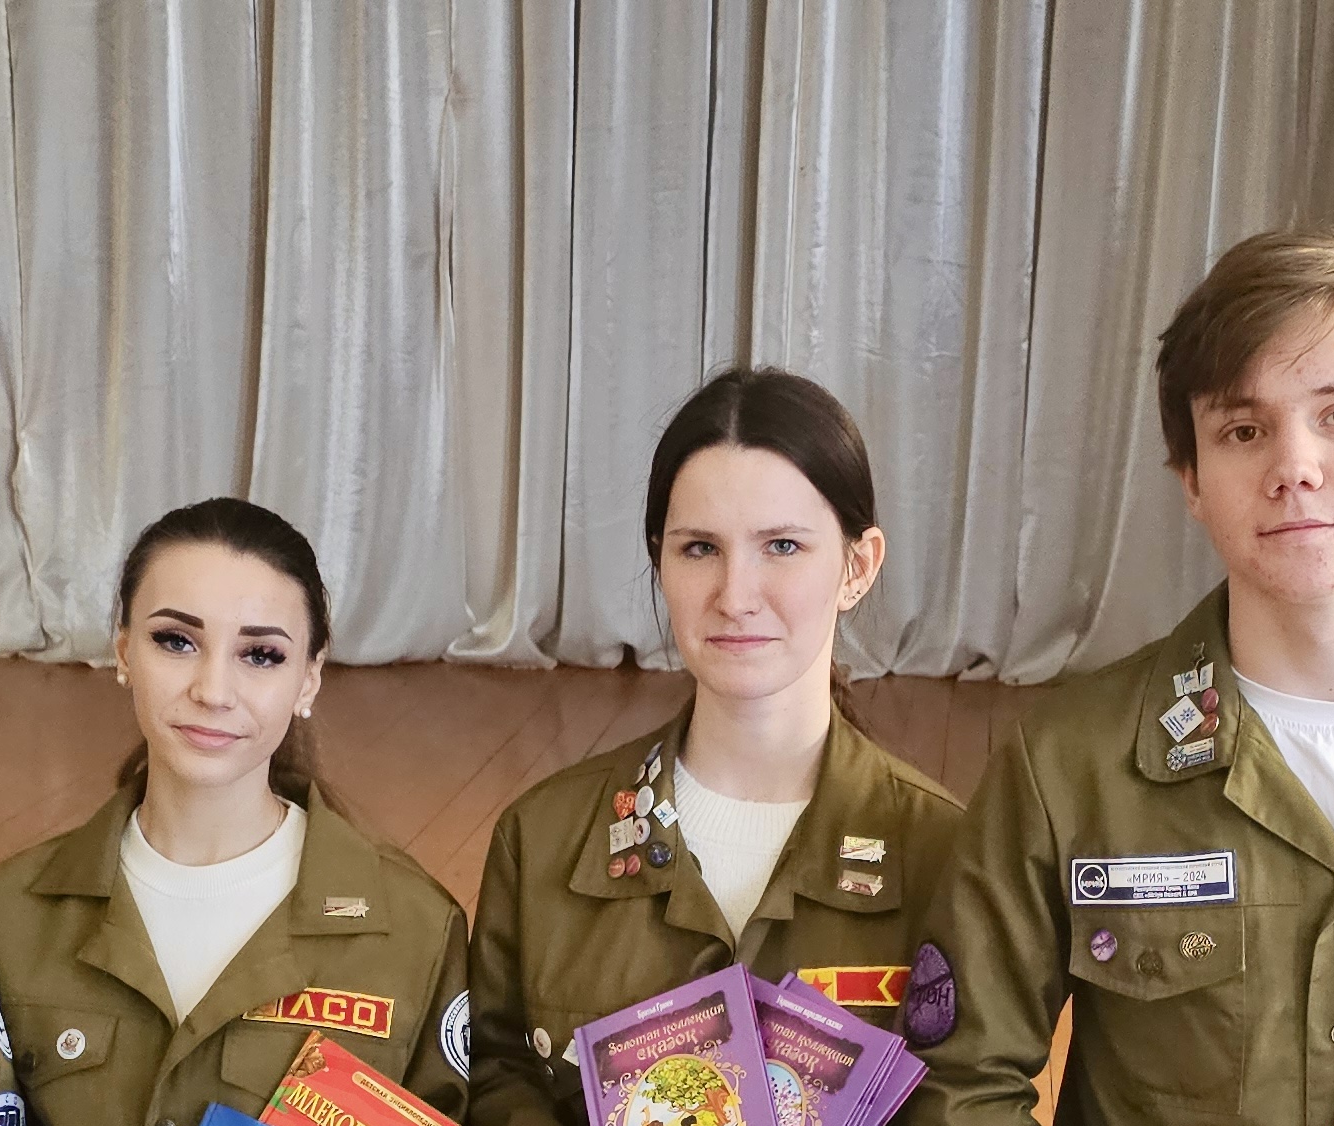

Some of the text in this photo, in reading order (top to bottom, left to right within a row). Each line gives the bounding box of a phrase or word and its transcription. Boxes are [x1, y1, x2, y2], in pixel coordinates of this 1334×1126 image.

[1127, 870, 1207, 884] «МРИЯ» 2024
[608, 1003, 725, 1056] Золотая коллекция
[637, 1029, 698, 1062] сказок
